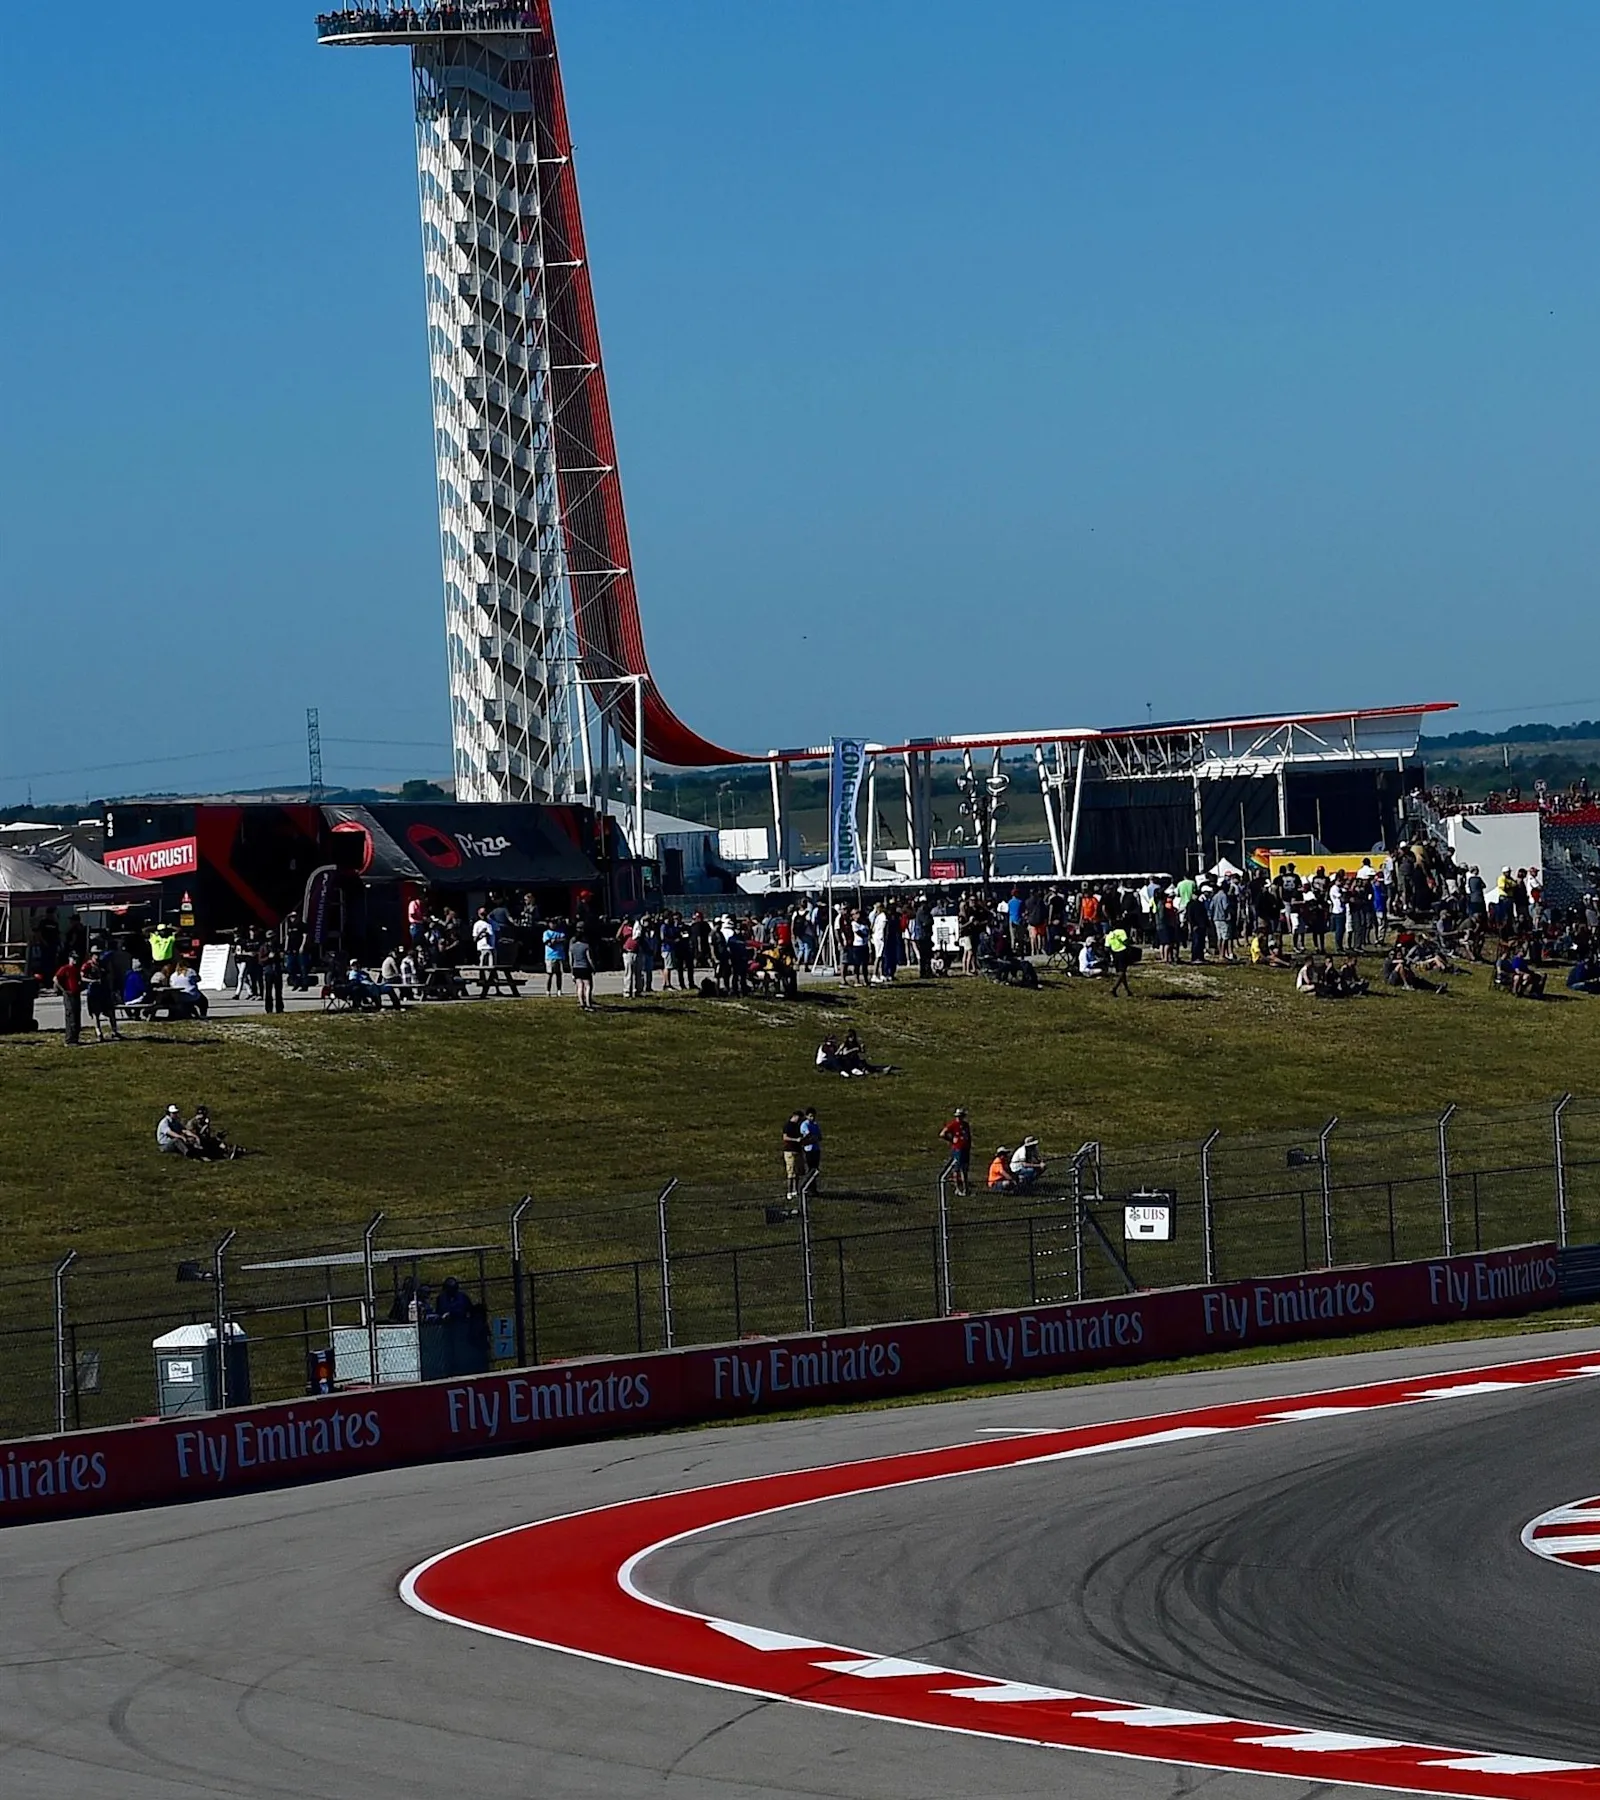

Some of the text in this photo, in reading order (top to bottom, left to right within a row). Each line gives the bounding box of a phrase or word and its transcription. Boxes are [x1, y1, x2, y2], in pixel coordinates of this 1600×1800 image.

[840, 741, 860, 872] CONCESSIONS
[454, 833, 511, 859] Pizza
[1143, 1208, 1165, 1220] UBS
[1203, 1279, 1375, 1338] Fly Emirates
[1428, 1256, 1557, 1311] Fly Emirates
[500, 1319, 508, 1335] F
[501, 1342, 508, 1353] 7
[963, 1309, 1144, 1370] Fly Emirates
[713, 1340, 902, 1405] Fly Emirates
[447, 1371, 650, 1437] Fly Emirates
[175, 1408, 381, 1482] Fly Emirates
